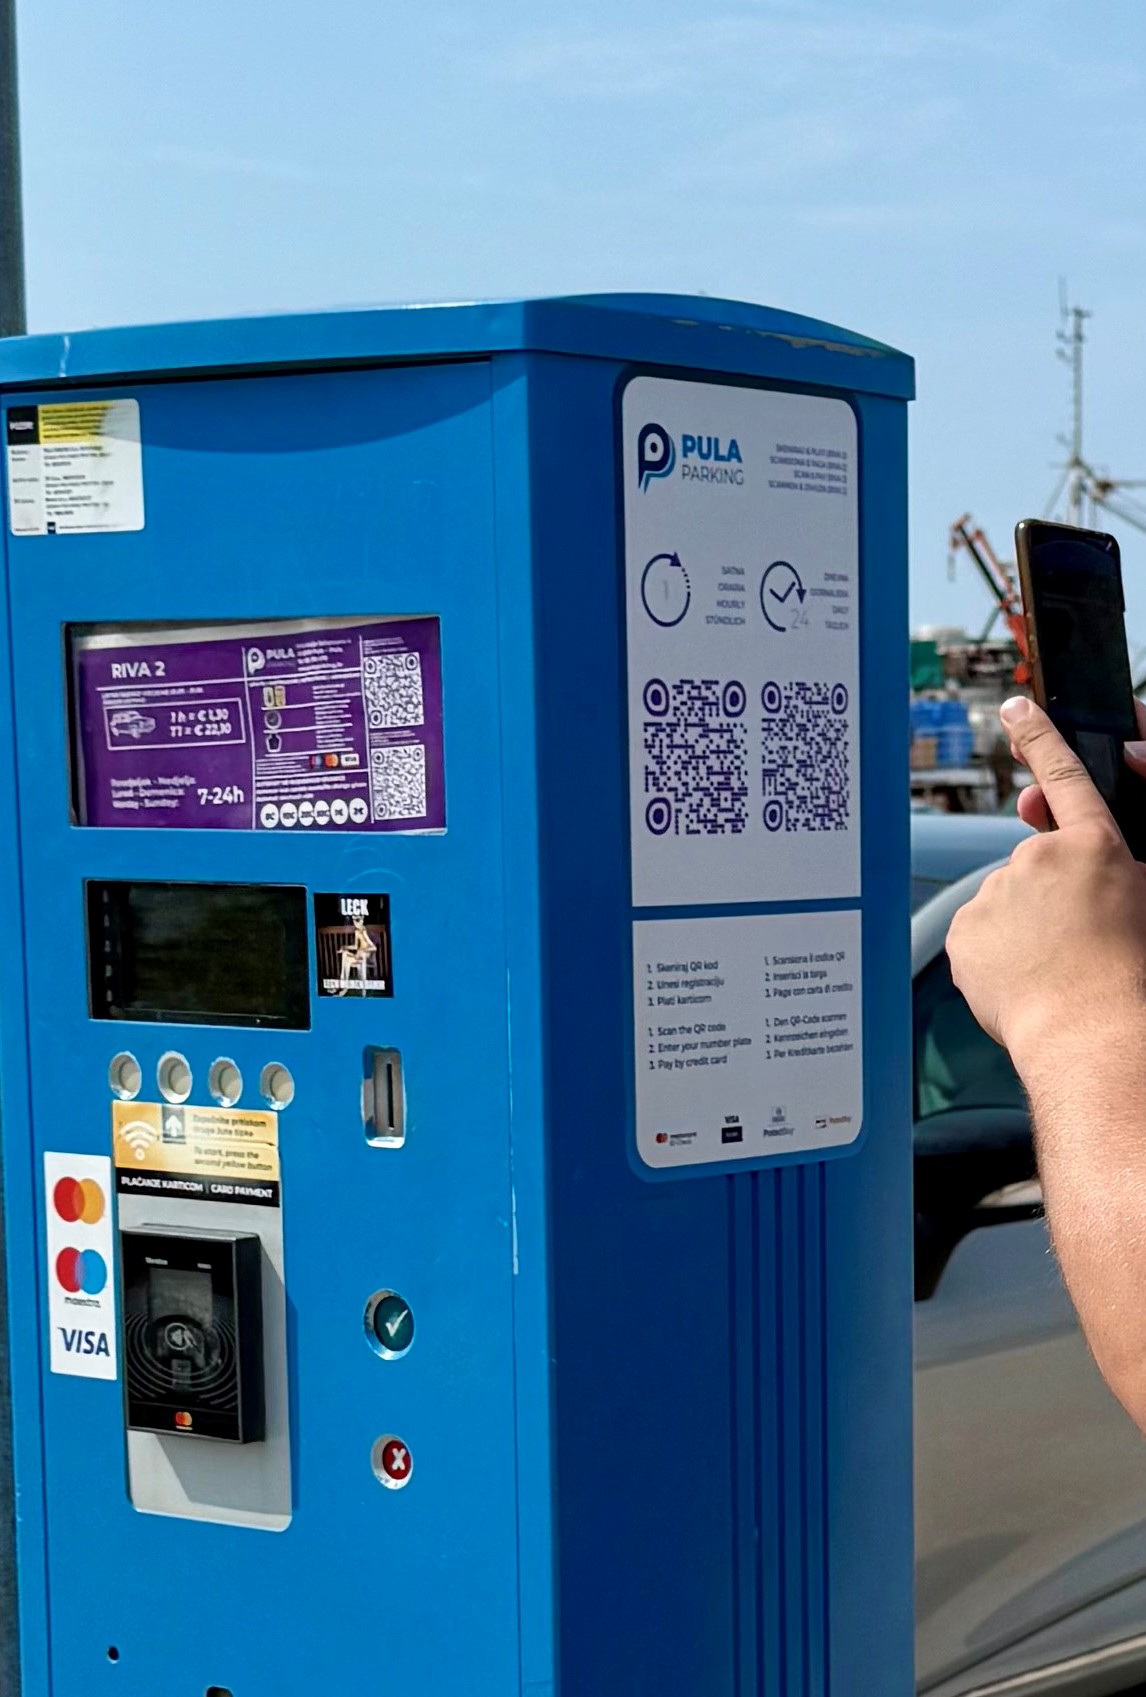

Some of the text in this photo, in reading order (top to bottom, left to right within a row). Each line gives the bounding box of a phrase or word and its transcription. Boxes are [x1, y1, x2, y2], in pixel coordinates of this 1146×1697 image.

[682, 433, 742, 463] PULA
[682, 464, 744, 486] PARKING
[266, 648, 296, 659] PULA
[111, 661, 166, 679] RIVA 2
[197, 785, 245, 805] 7-24h
[341, 898, 369, 916] LECK
[690, 961, 702, 972] QR
[658, 1027, 677, 1037] Scan
[678, 1025, 692, 1035] the
[694, 1023, 706, 1035] QR
[707, 1023, 727, 1033] code
[658, 1043, 680, 1053] Enter
[681, 1042, 699, 1053] your
[700, 1039, 731, 1049] number
[733, 1037, 752, 1049] plate
[658, 1059, 673, 1071] Pay
[674, 1058, 684, 1070] by
[685, 1056, 709, 1067] credit
[710, 1055, 728, 1065] card
[225, 1150, 245, 1158] press
[247, 1151, 259, 1159] the
[222, 1161, 246, 1169] yellow
[247, 1162, 273, 1171] button
[211, 1184, 234, 1195] CARD
[235, 1186, 274, 1198] PAYMENT
[57, 1327, 110, 1358] VISA
